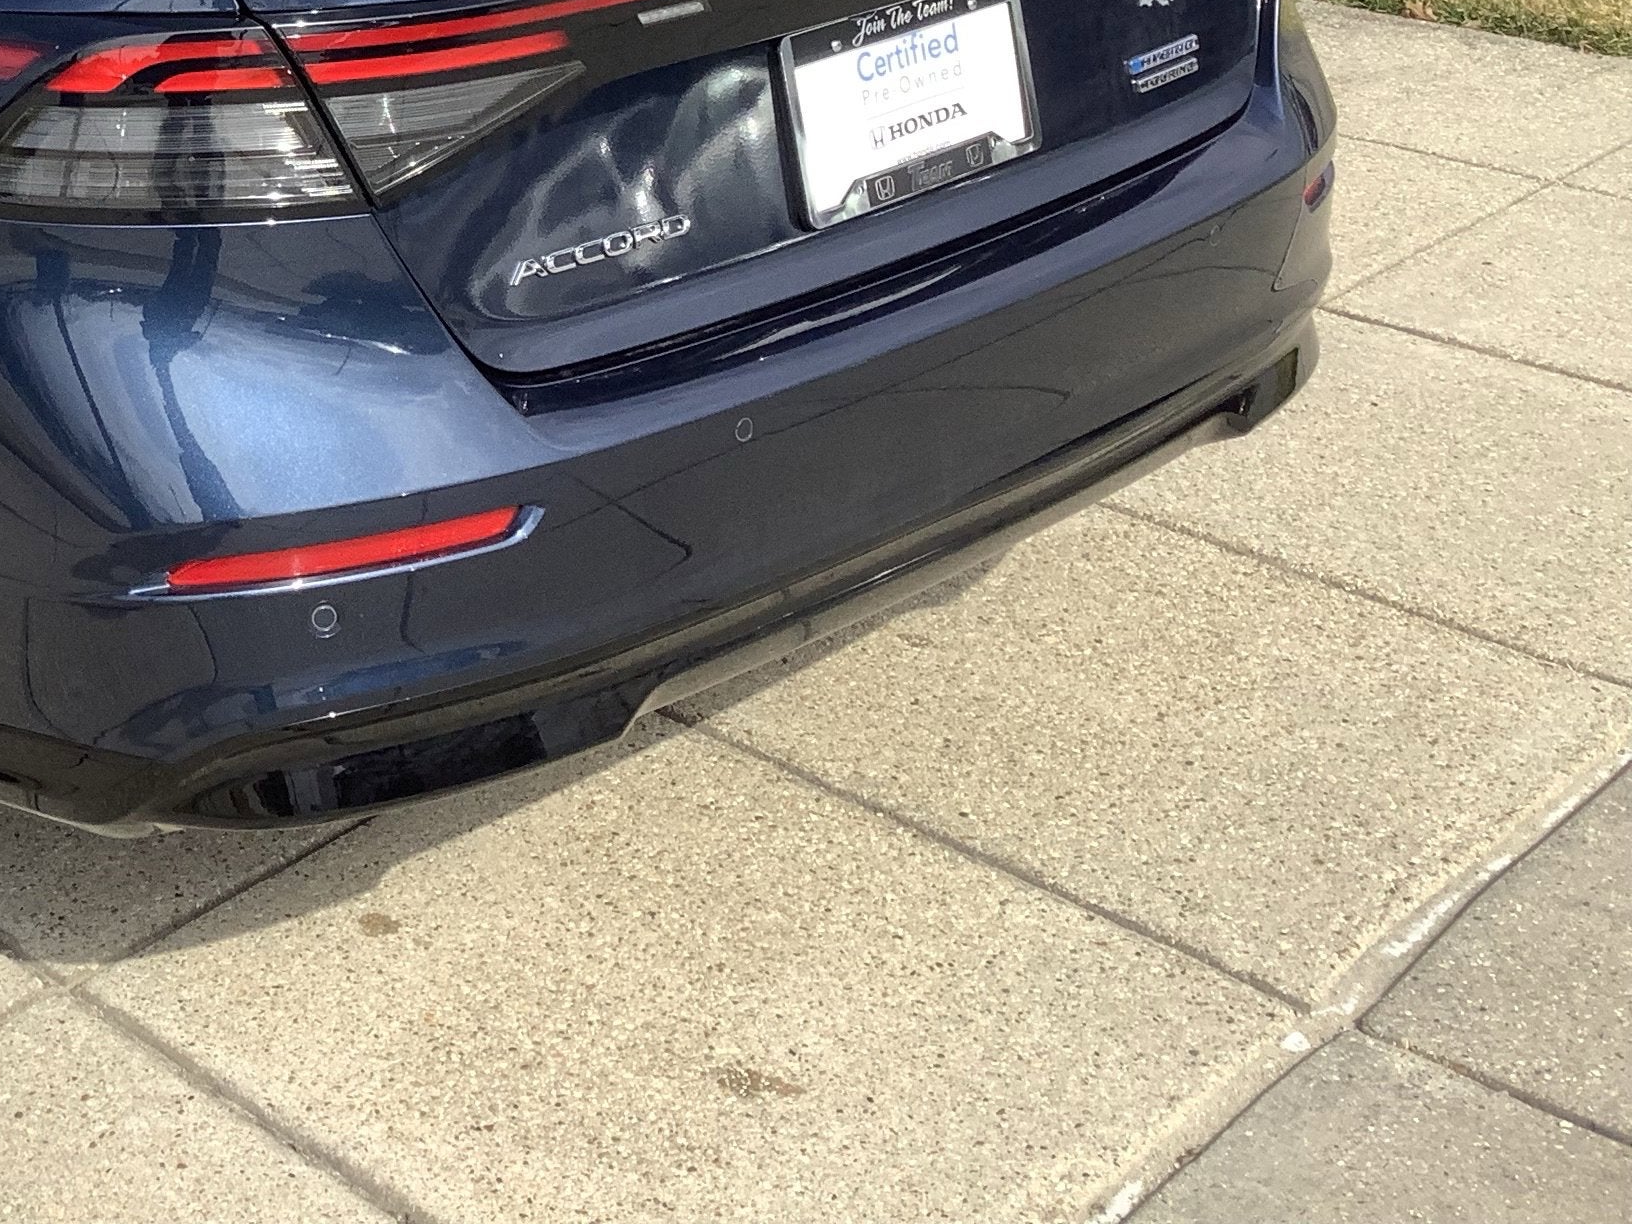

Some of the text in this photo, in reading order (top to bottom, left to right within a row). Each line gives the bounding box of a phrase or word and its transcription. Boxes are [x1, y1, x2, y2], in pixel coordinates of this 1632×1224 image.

[852, 15, 887, 46] Join
[885, 5, 913, 27] The
[856, 23, 960, 82] Certified
[1142, 36, 1198, 70] HYBRID
[862, 62, 963, 106] Pre-Owned
[1139, 61, 1197, 91] TOURING
[889, 102, 968, 142] HONDA
[509, 214, 692, 286] ACCORD
